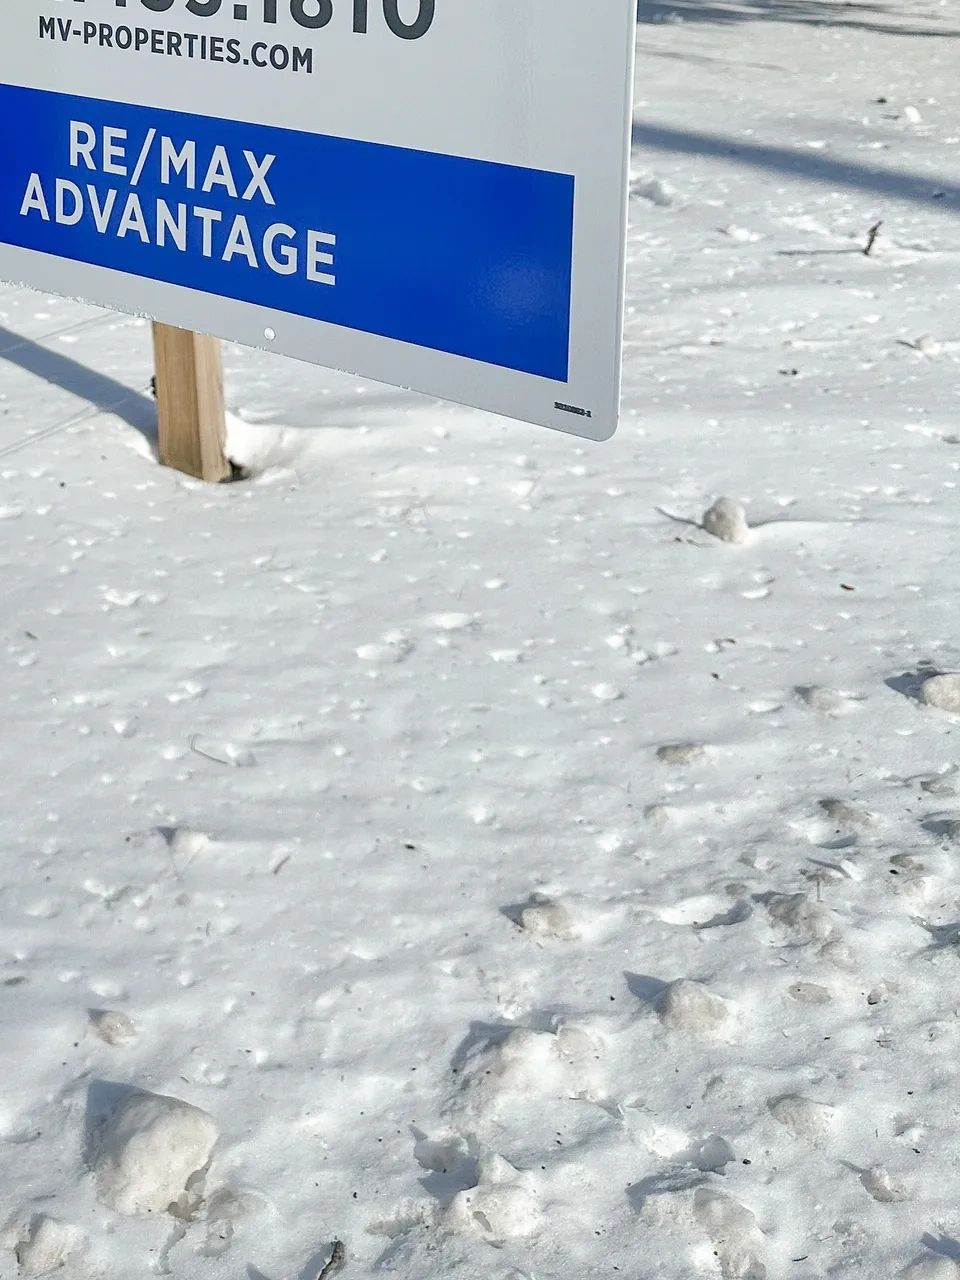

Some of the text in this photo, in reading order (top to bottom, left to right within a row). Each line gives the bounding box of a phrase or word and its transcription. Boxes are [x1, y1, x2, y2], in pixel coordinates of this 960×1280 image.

[39, 15, 313, 74] MV-PROPERTIES.COM
[69, 120, 277, 206] RE/MAX
[19, 172, 337, 287] ADVANTAGE
